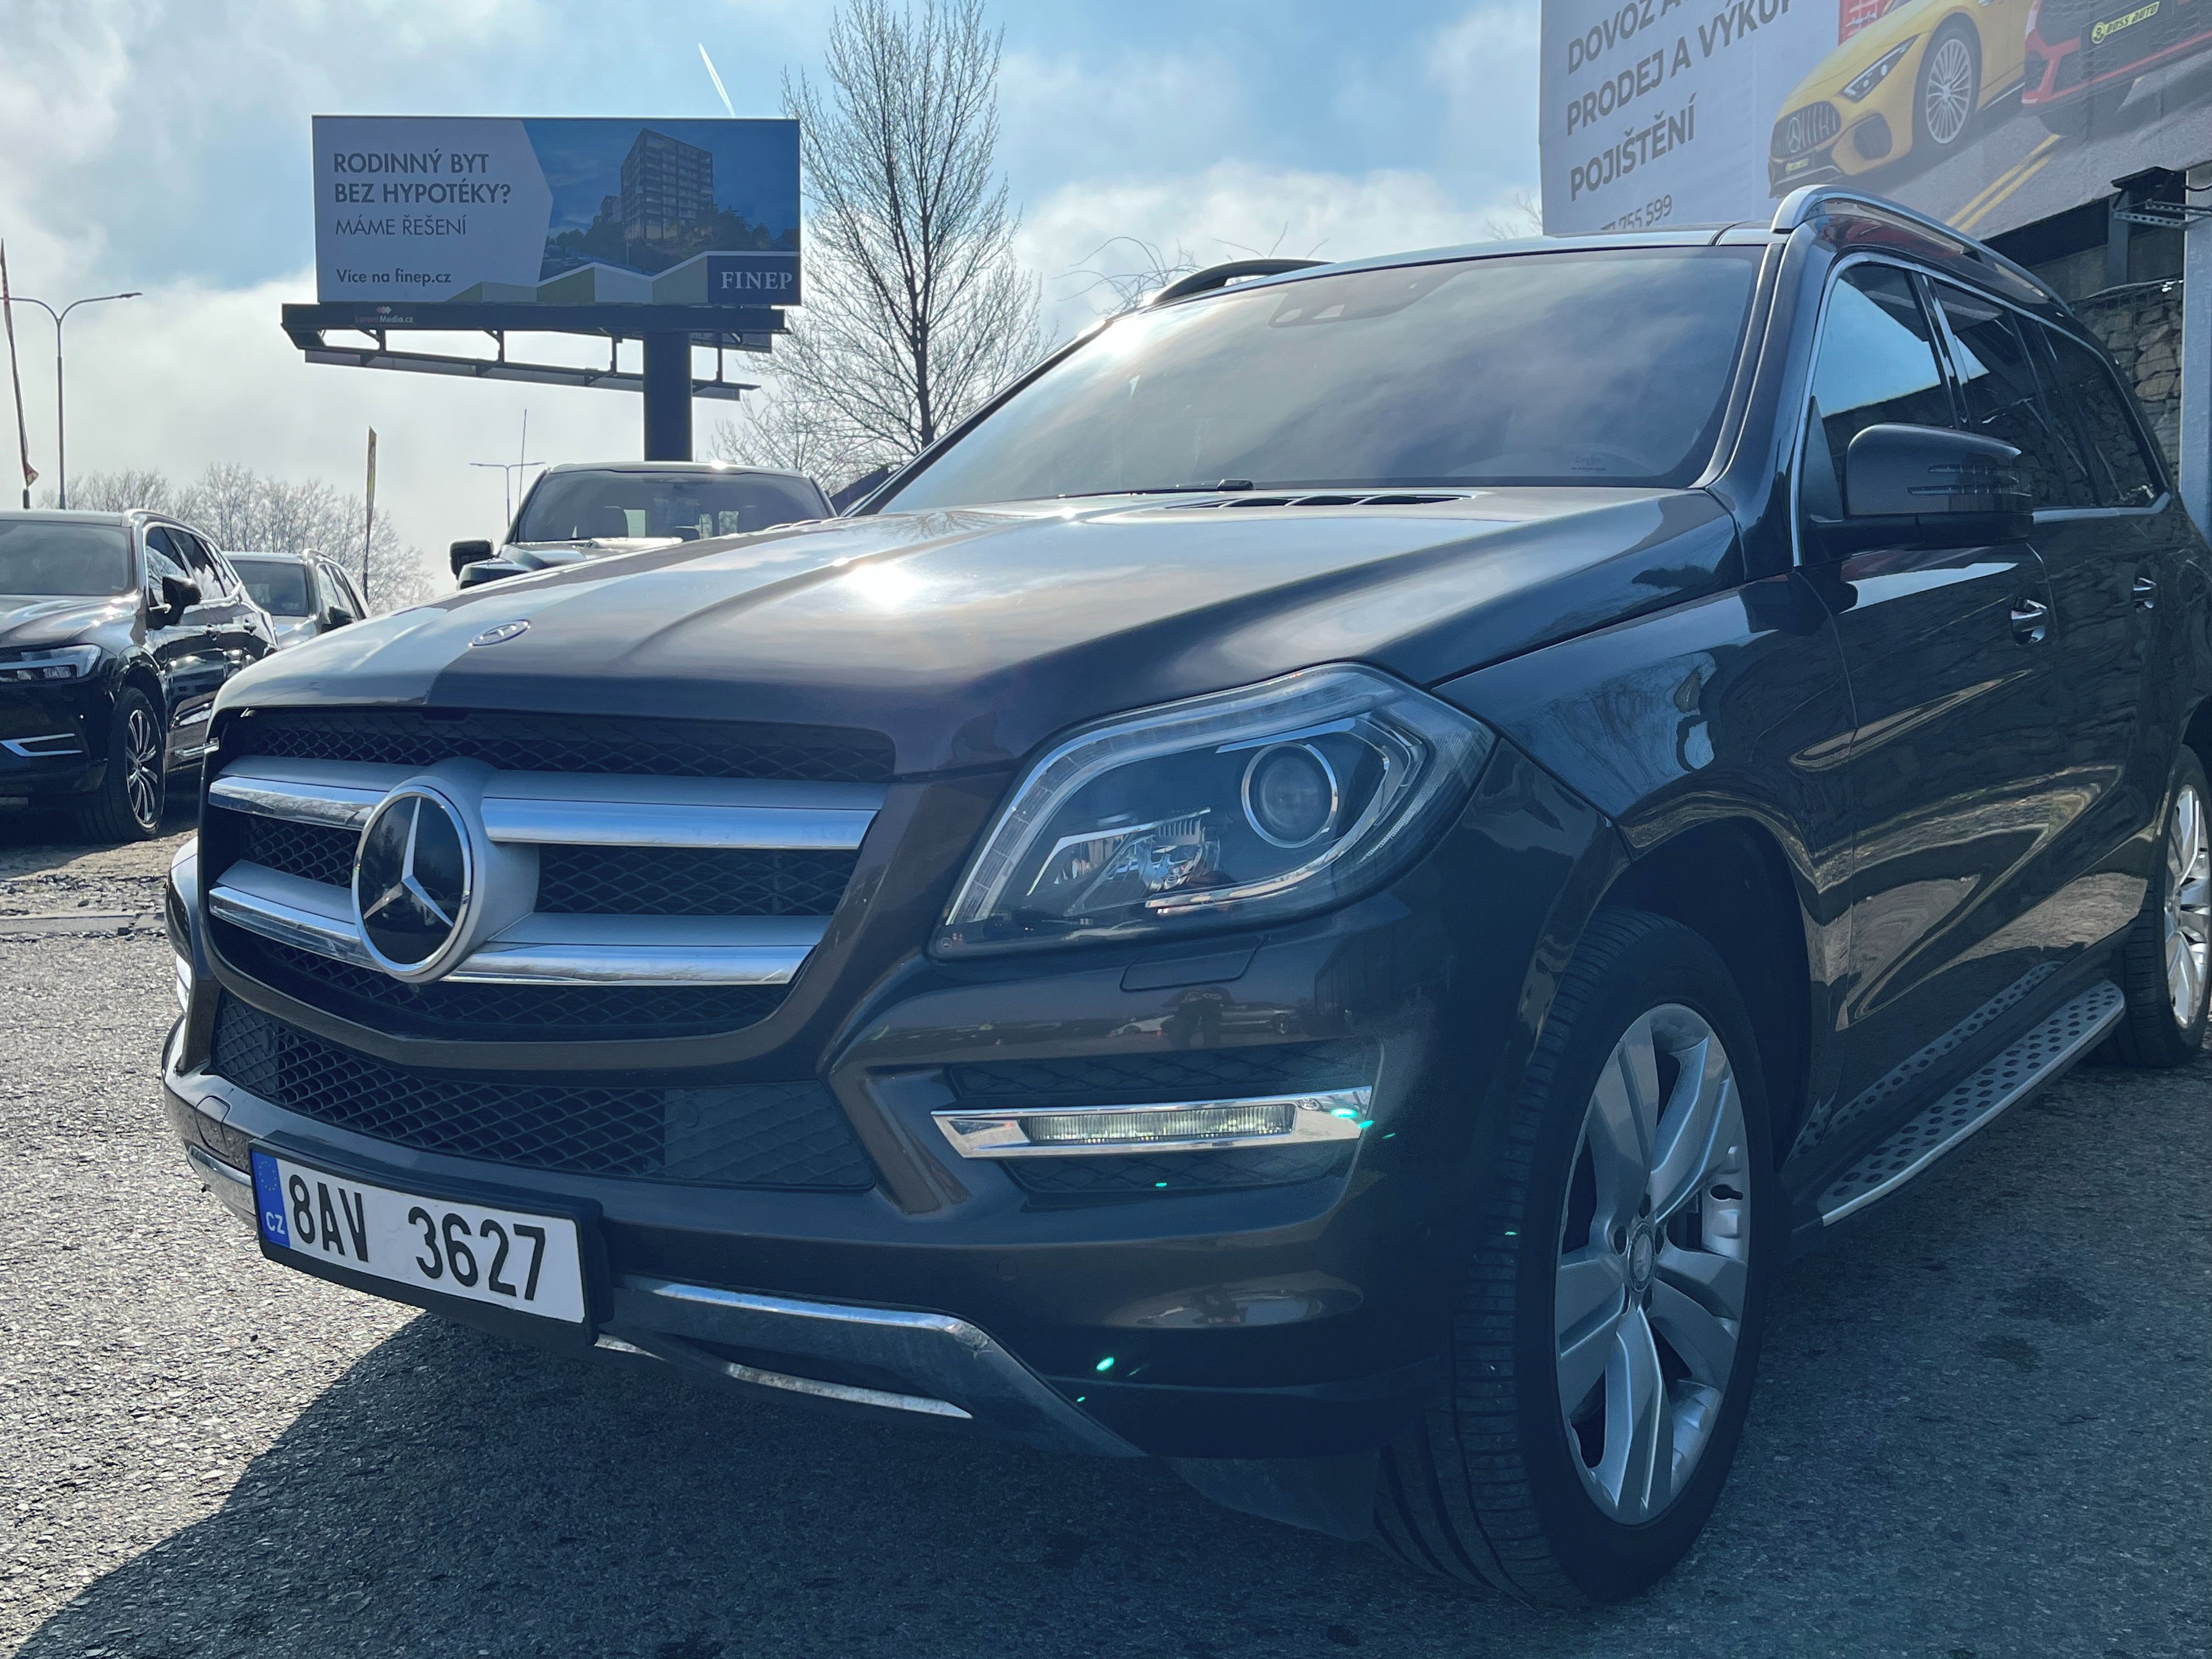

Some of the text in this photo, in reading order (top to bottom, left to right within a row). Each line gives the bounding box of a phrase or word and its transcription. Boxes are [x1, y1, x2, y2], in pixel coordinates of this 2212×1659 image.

[1567, 49, 1664, 136] PRODEJ
[1671, 37, 1692, 77] A
[1571, 92, 1698, 201] POJIŠTĚNÍ
[334, 149, 489, 173] RODINNÝ BYT
[335, 178, 511, 204] BEZ HYPOTÉKY?
[1646, 194, 1672, 227] 599
[335, 215, 466, 235] MÁME ŘEŠENÍ
[336, 268, 452, 286] Více na finep.cz
[721, 272, 793, 289] FINEP
[266, 1211, 286, 1235] CZ
[289, 1174, 546, 1301] 8AV 3627
